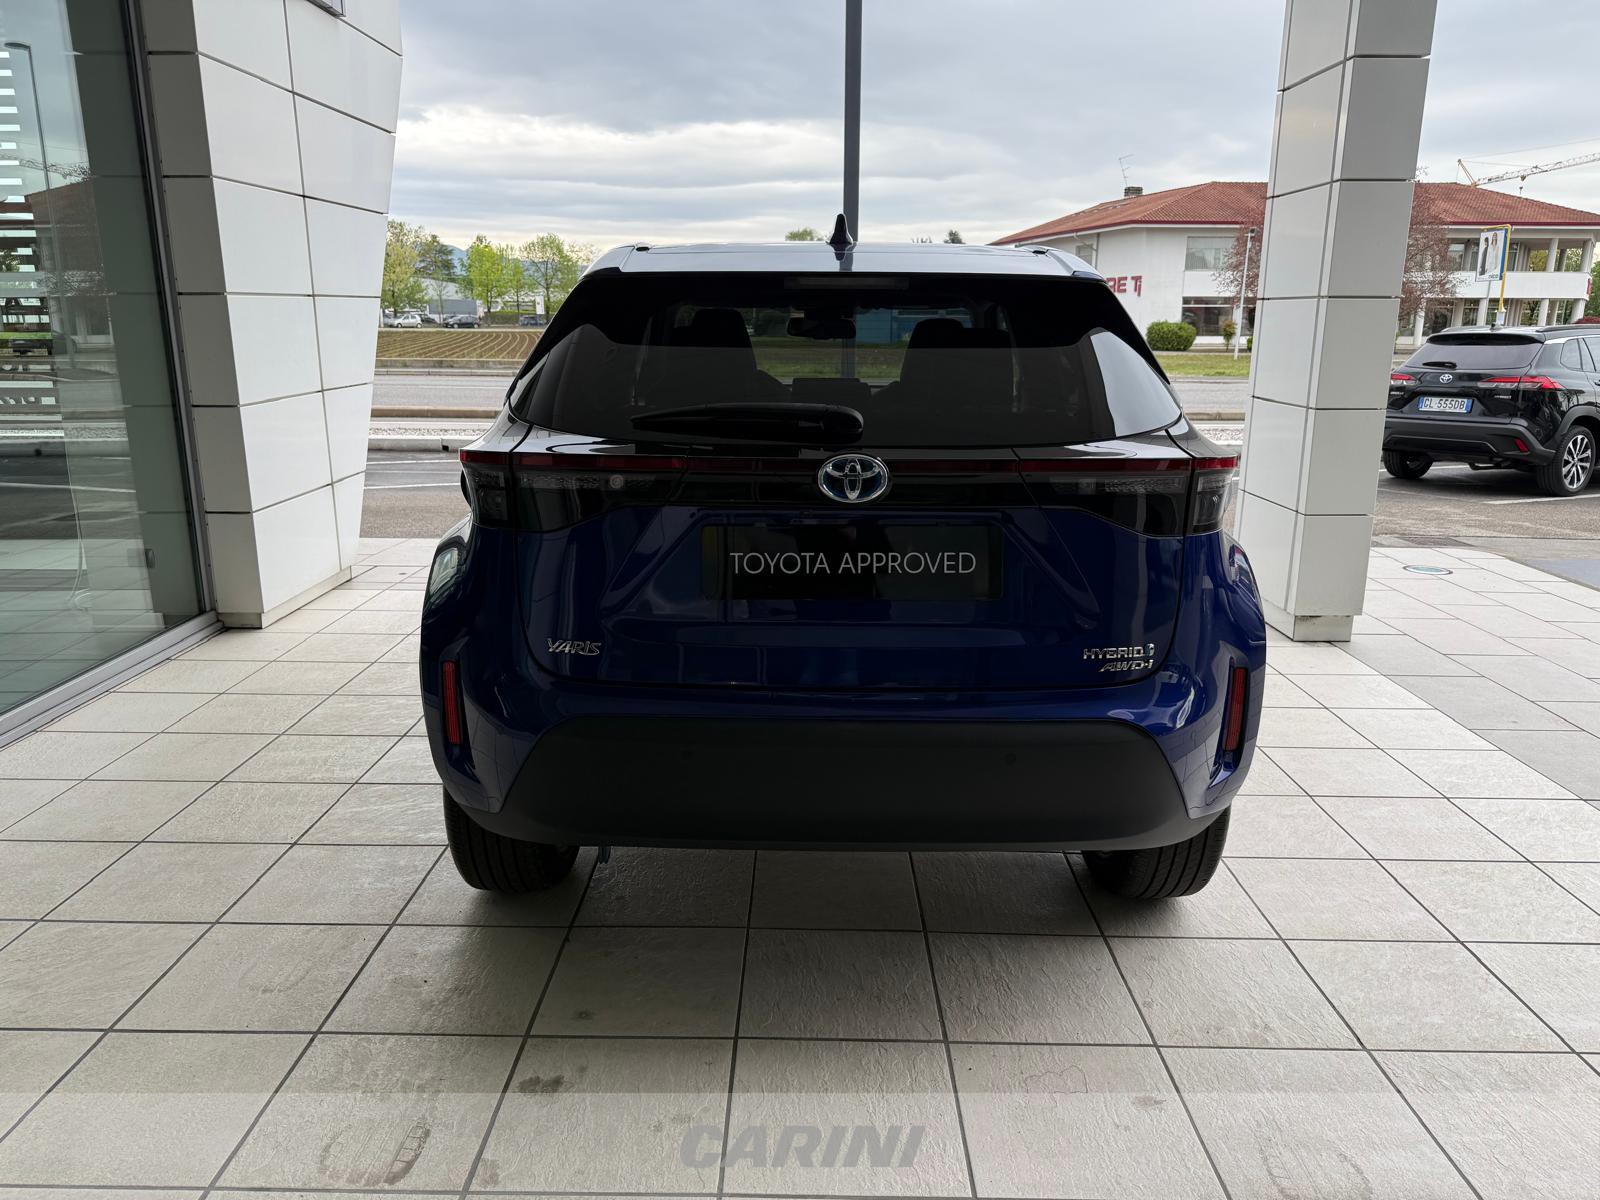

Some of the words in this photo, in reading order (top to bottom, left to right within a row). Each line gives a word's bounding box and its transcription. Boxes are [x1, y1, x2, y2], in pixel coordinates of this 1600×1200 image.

[729, 552, 831, 574] TOYOTA
[838, 552, 977, 574] APPROVED
[547, 638, 602, 656] YARIS
[1083, 646, 1144, 660] HYBRID
